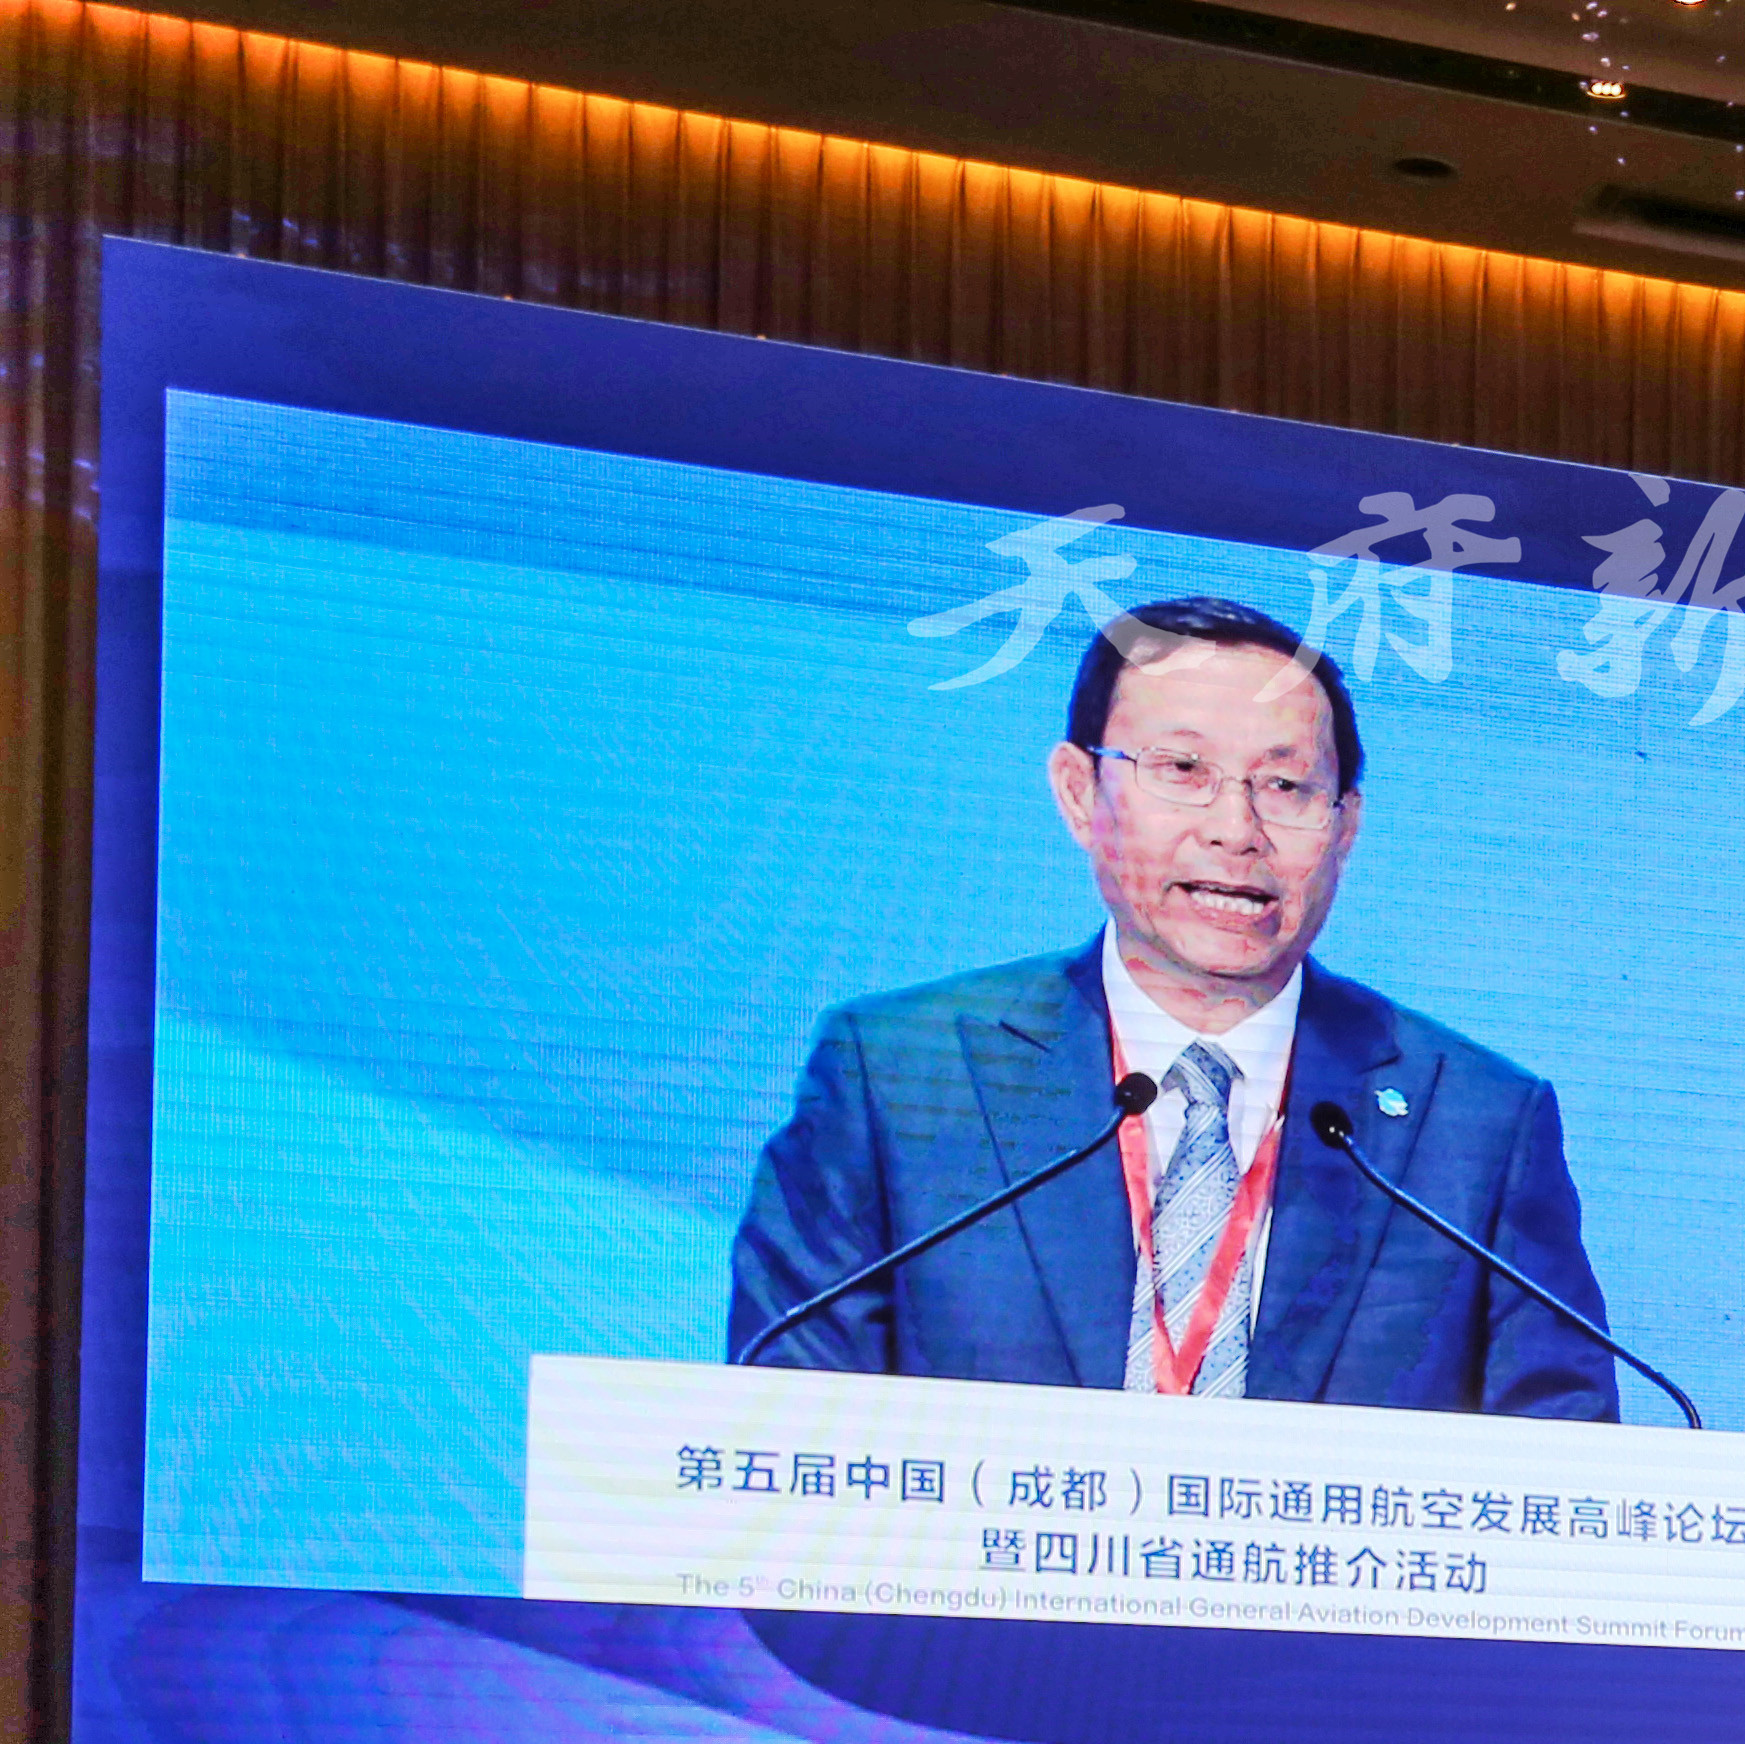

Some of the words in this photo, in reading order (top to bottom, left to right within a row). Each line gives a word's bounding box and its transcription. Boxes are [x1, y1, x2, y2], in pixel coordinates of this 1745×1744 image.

[980, 1528, 1487, 1595] 暨四川省通航推介活动
[677, 1573, 729, 1597] The
[777, 1578, 856, 1602] China
[865, 1581, 1007, 1612] (Chengdu)
[1015, 1589, 1182, 1618] International
[1189, 1598, 1291, 1621] General
[1298, 1604, 1400, 1627] Aviation
[1408, 1607, 1568, 1637] Development
[1576, 1615, 1667, 1639] Summit
